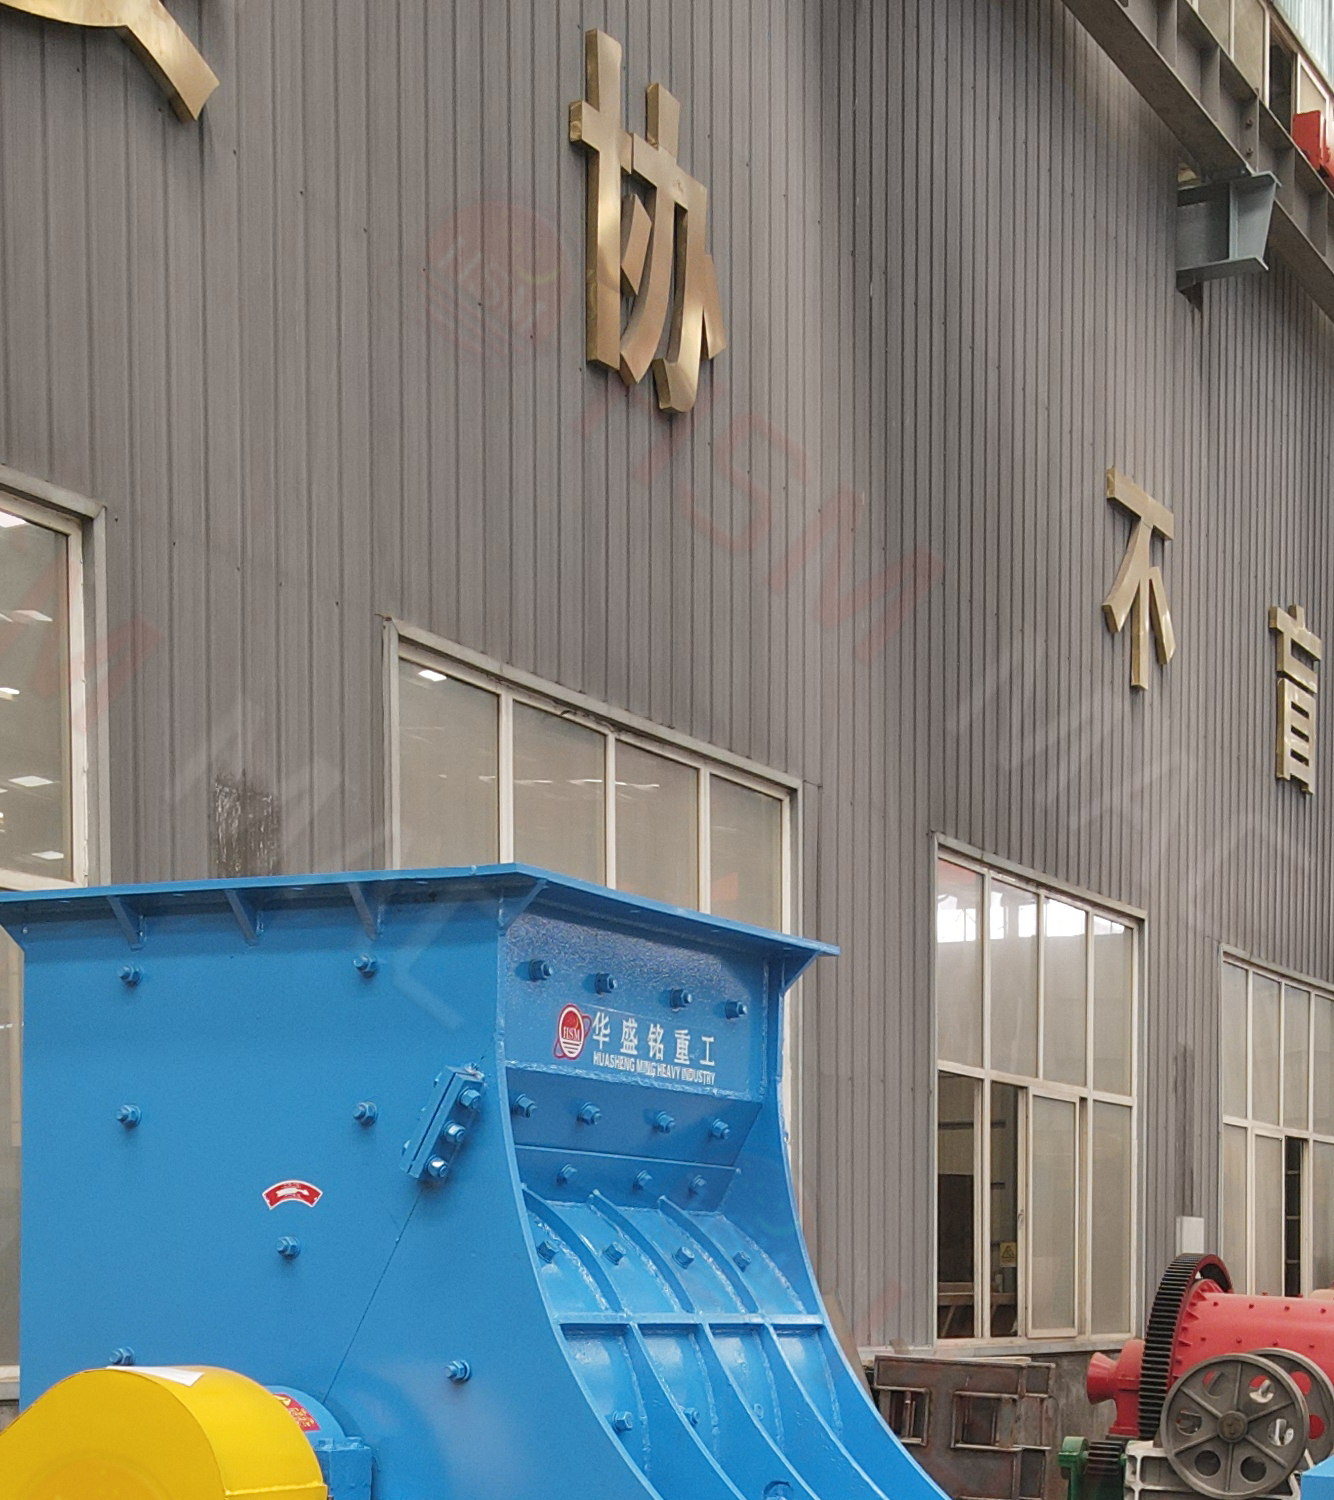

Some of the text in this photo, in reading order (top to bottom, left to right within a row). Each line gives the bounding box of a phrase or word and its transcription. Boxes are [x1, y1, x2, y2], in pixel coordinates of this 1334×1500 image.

[563, 1026, 581, 1041] HSM
[591, 1011, 716, 1067] 华盛铭重工
[593, 1050, 716, 1086] HUASHENG MING HEAVY INDUSTRY
